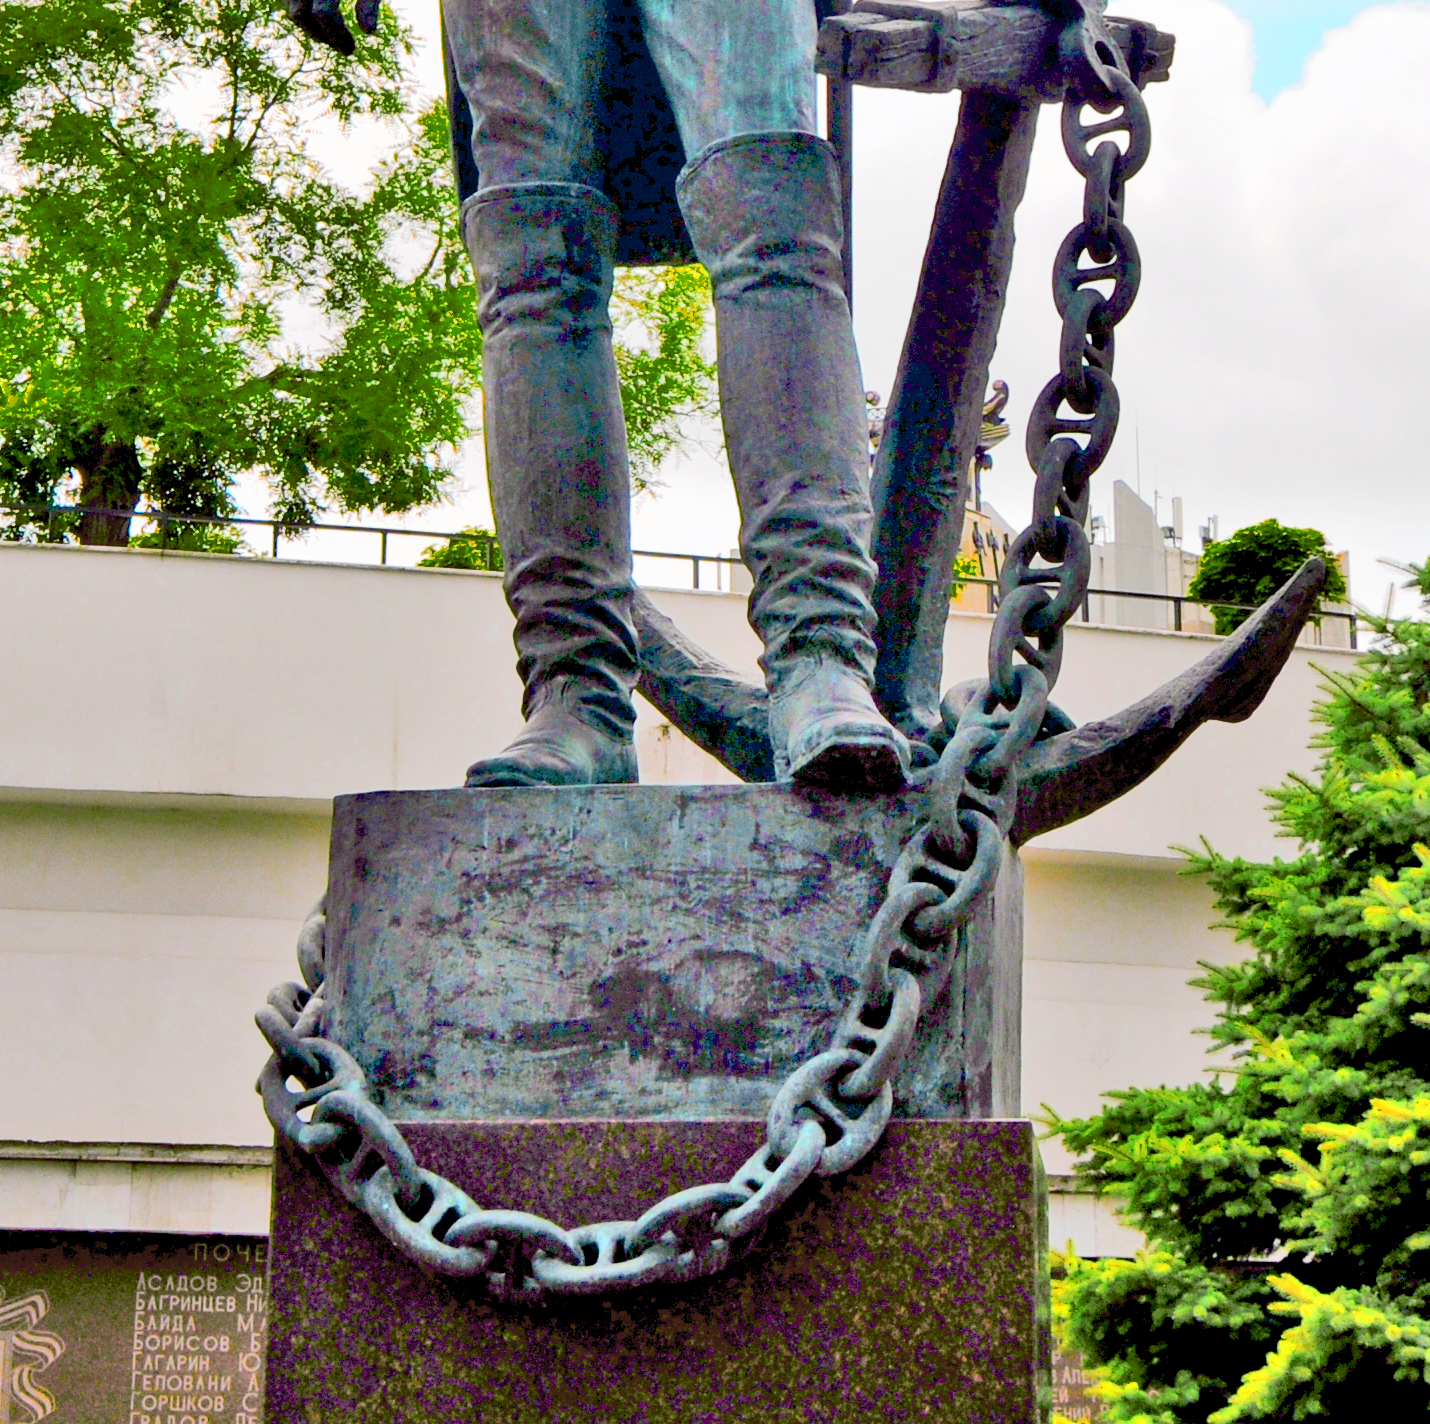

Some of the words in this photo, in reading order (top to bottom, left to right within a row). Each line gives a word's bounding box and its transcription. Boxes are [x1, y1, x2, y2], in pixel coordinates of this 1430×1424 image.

[136, 1271, 218, 1292] АСАДОВ
[134, 1291, 237, 1314] БАГРИНЦЕВ
[132, 1330, 231, 1352] БОРИСОВ
[132, 1351, 210, 1372] ГАГАРИН
[131, 1371, 231, 1392] ГЕЛОВАНИ
[130, 1391, 225, 1412] ГОРШКОВ
